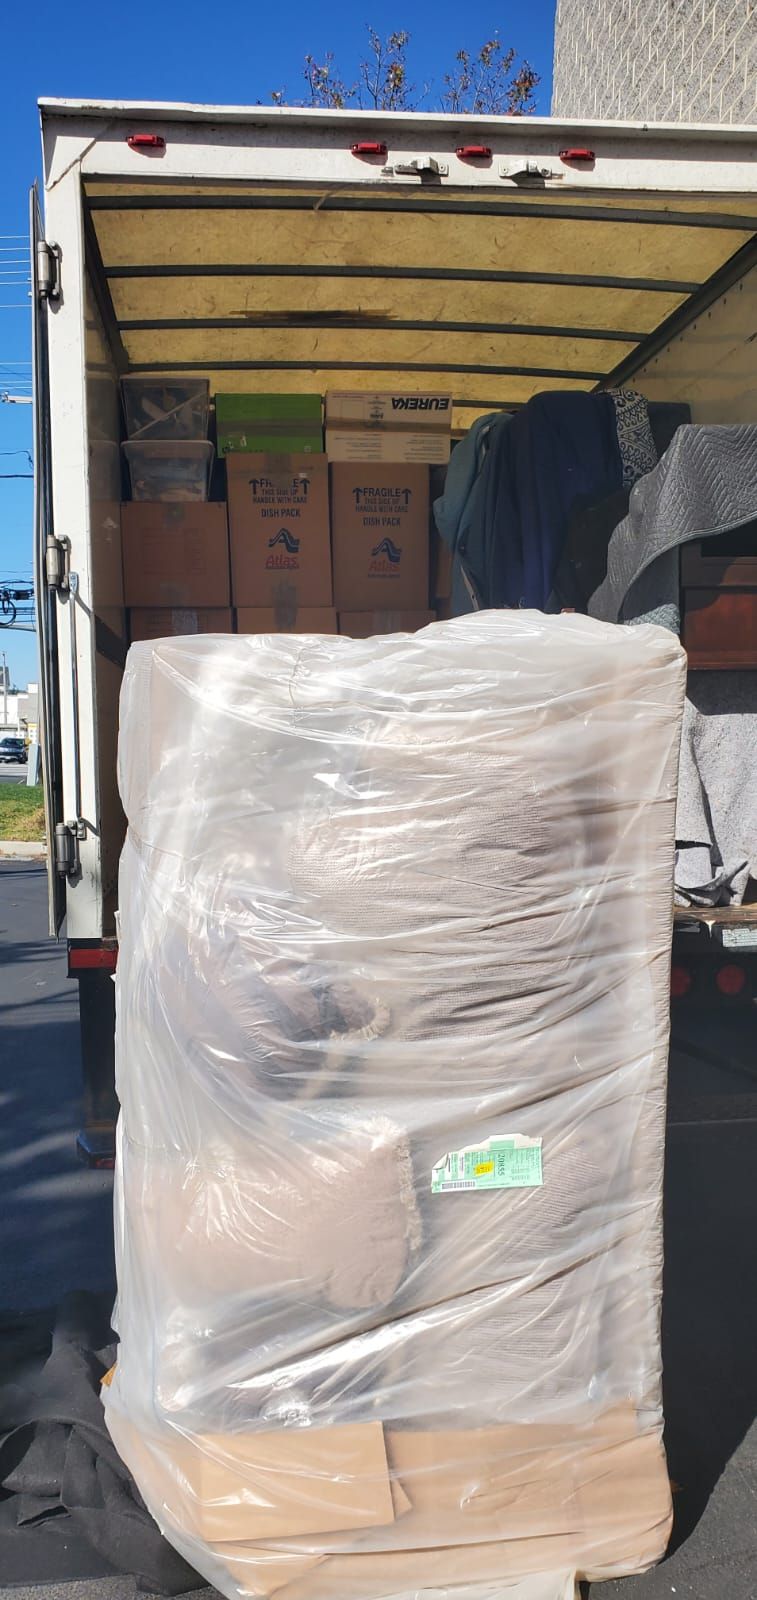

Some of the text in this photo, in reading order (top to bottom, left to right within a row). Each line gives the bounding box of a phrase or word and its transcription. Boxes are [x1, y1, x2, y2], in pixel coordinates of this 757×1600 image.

[391, 397, 450, 410] EUREKA
[290, 488, 298, 496] UP
[363, 487, 401, 497] FRAGILE
[253, 496, 307, 504] HANDLE WITH CARE
[261, 508, 301, 518] DISH PACK
[356, 505, 408, 513] HANDLE WITH CARE
[363, 517, 400, 526] DISH PACK
[265, 554, 297, 566] Atlas
[368, 559, 401, 572] Atlas
